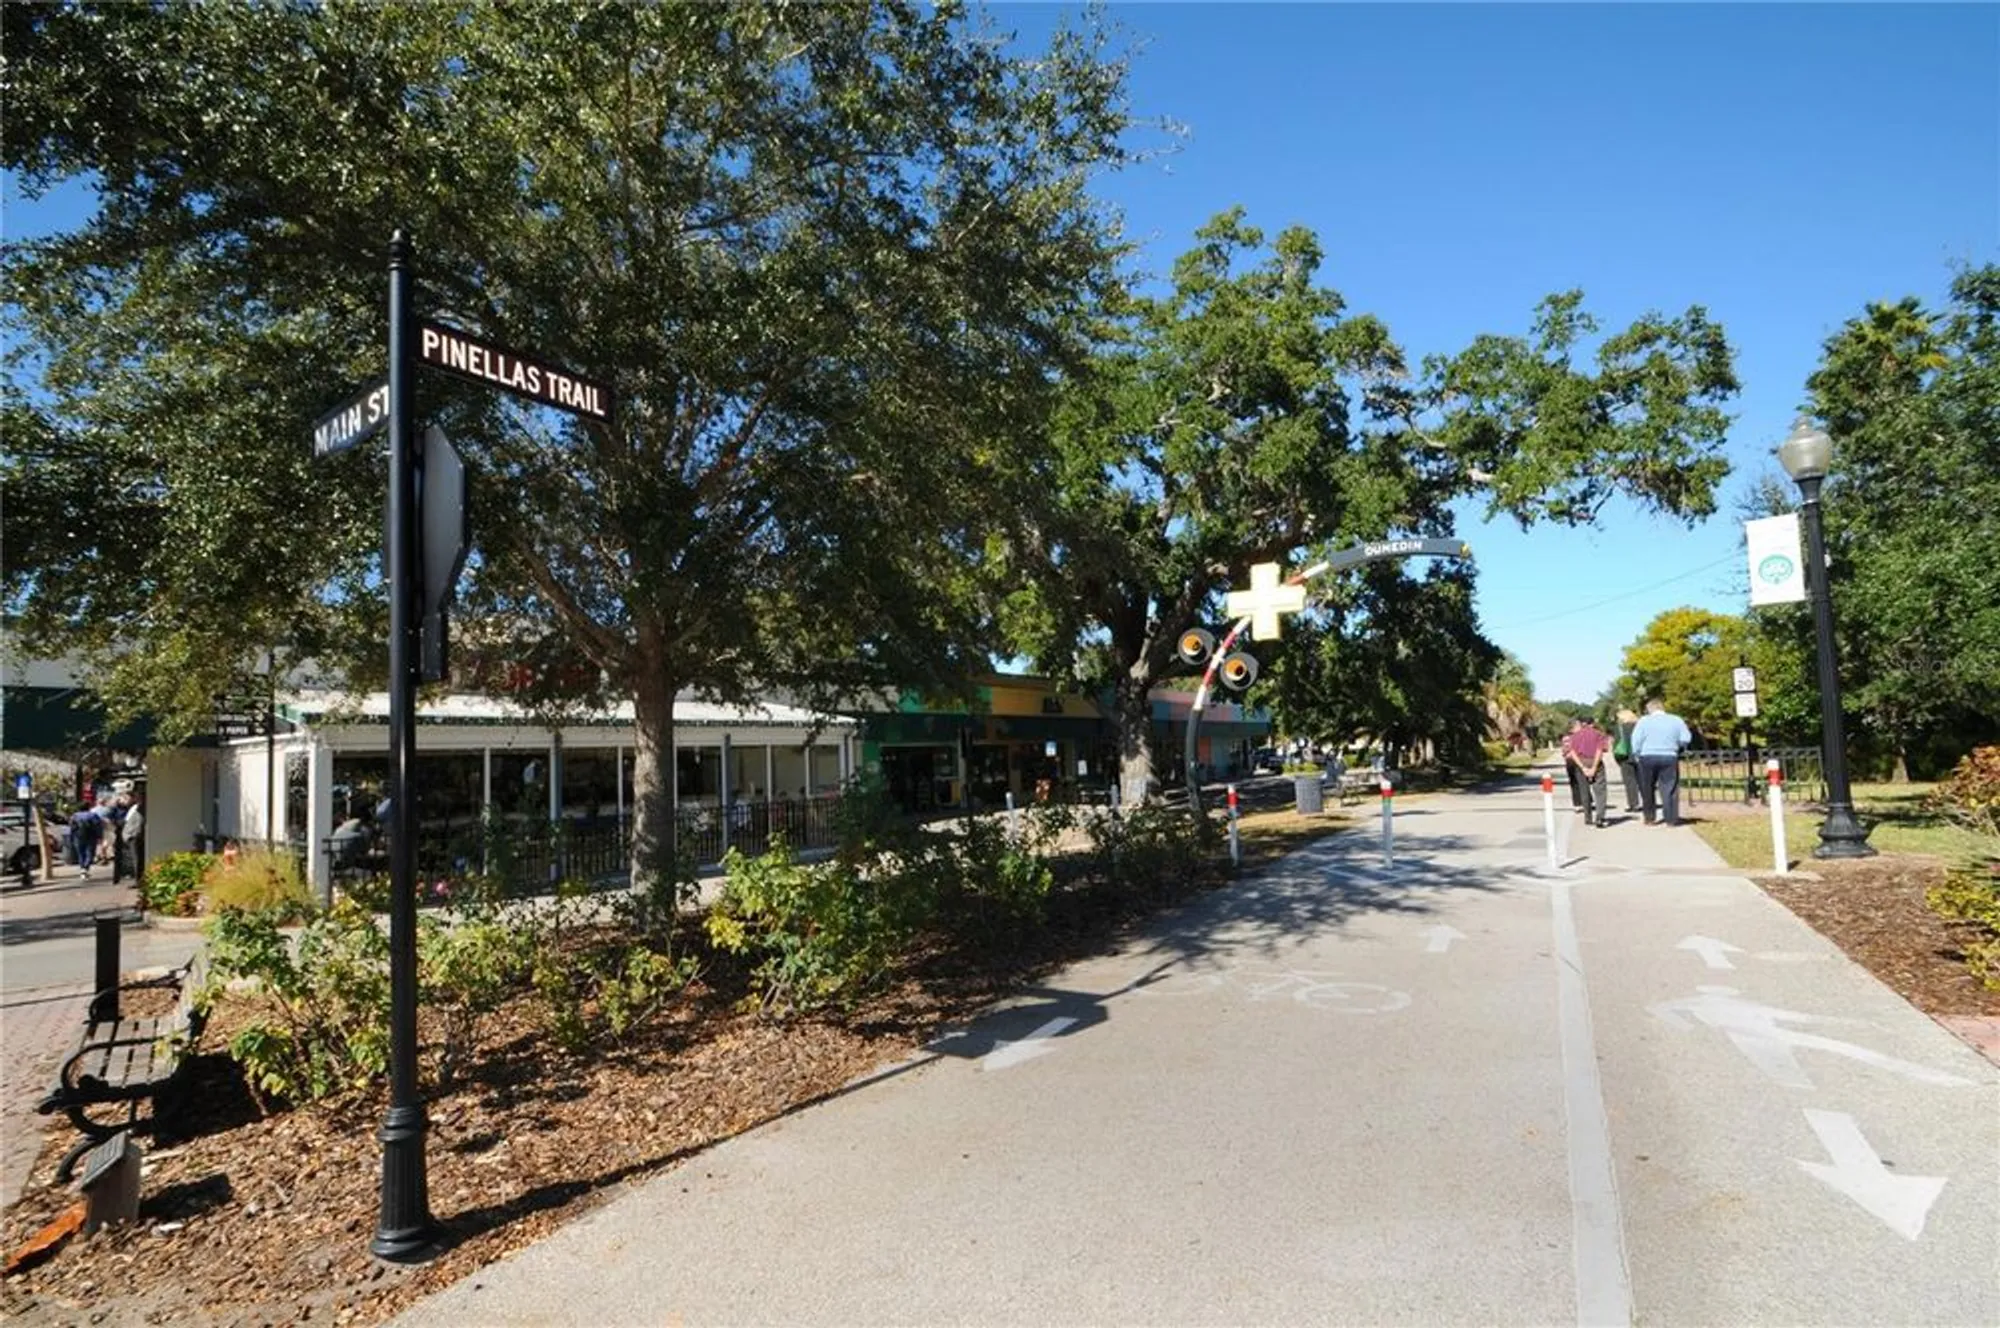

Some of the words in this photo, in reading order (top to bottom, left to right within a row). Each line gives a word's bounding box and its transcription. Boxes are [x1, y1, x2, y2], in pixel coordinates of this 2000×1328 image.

[422, 328, 541, 393] PINELLAS
[546, 371, 605, 416] TRAIL
[314, 403, 361, 457] MAIN
[367, 384, 389, 424] ST
[1364, 541, 1422, 557] DUNEDIN
